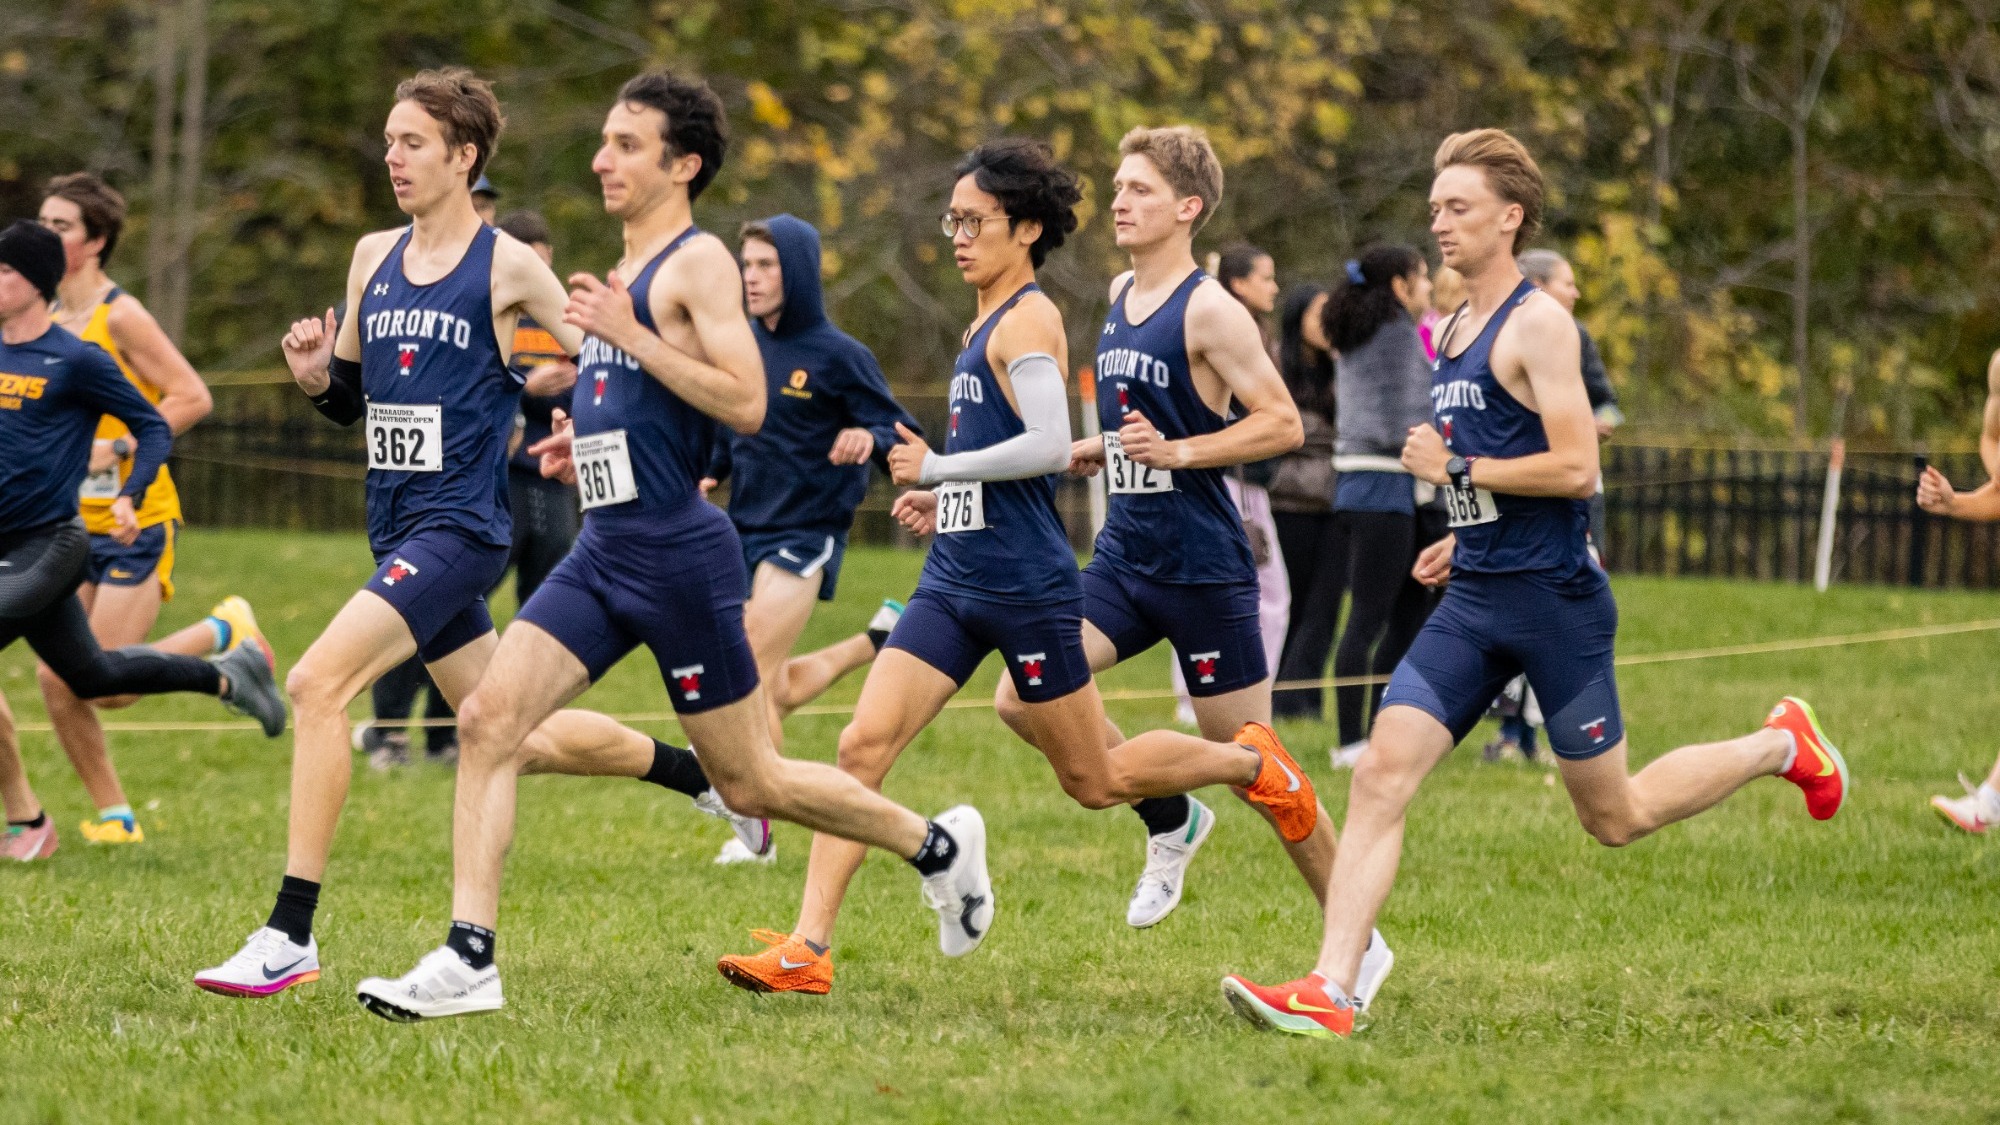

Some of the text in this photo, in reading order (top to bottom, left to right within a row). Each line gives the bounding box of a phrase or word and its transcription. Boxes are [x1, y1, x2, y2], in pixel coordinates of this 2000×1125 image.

[366, 309, 471, 350] TORONTO
[1097, 348, 1169, 389] TORONTO
[373, 426, 426, 467] 362
[580, 458, 616, 503] 361
[1113, 453, 1157, 488] 372
[941, 490, 973, 529] 376
[1446, 486, 1482, 523] 368
